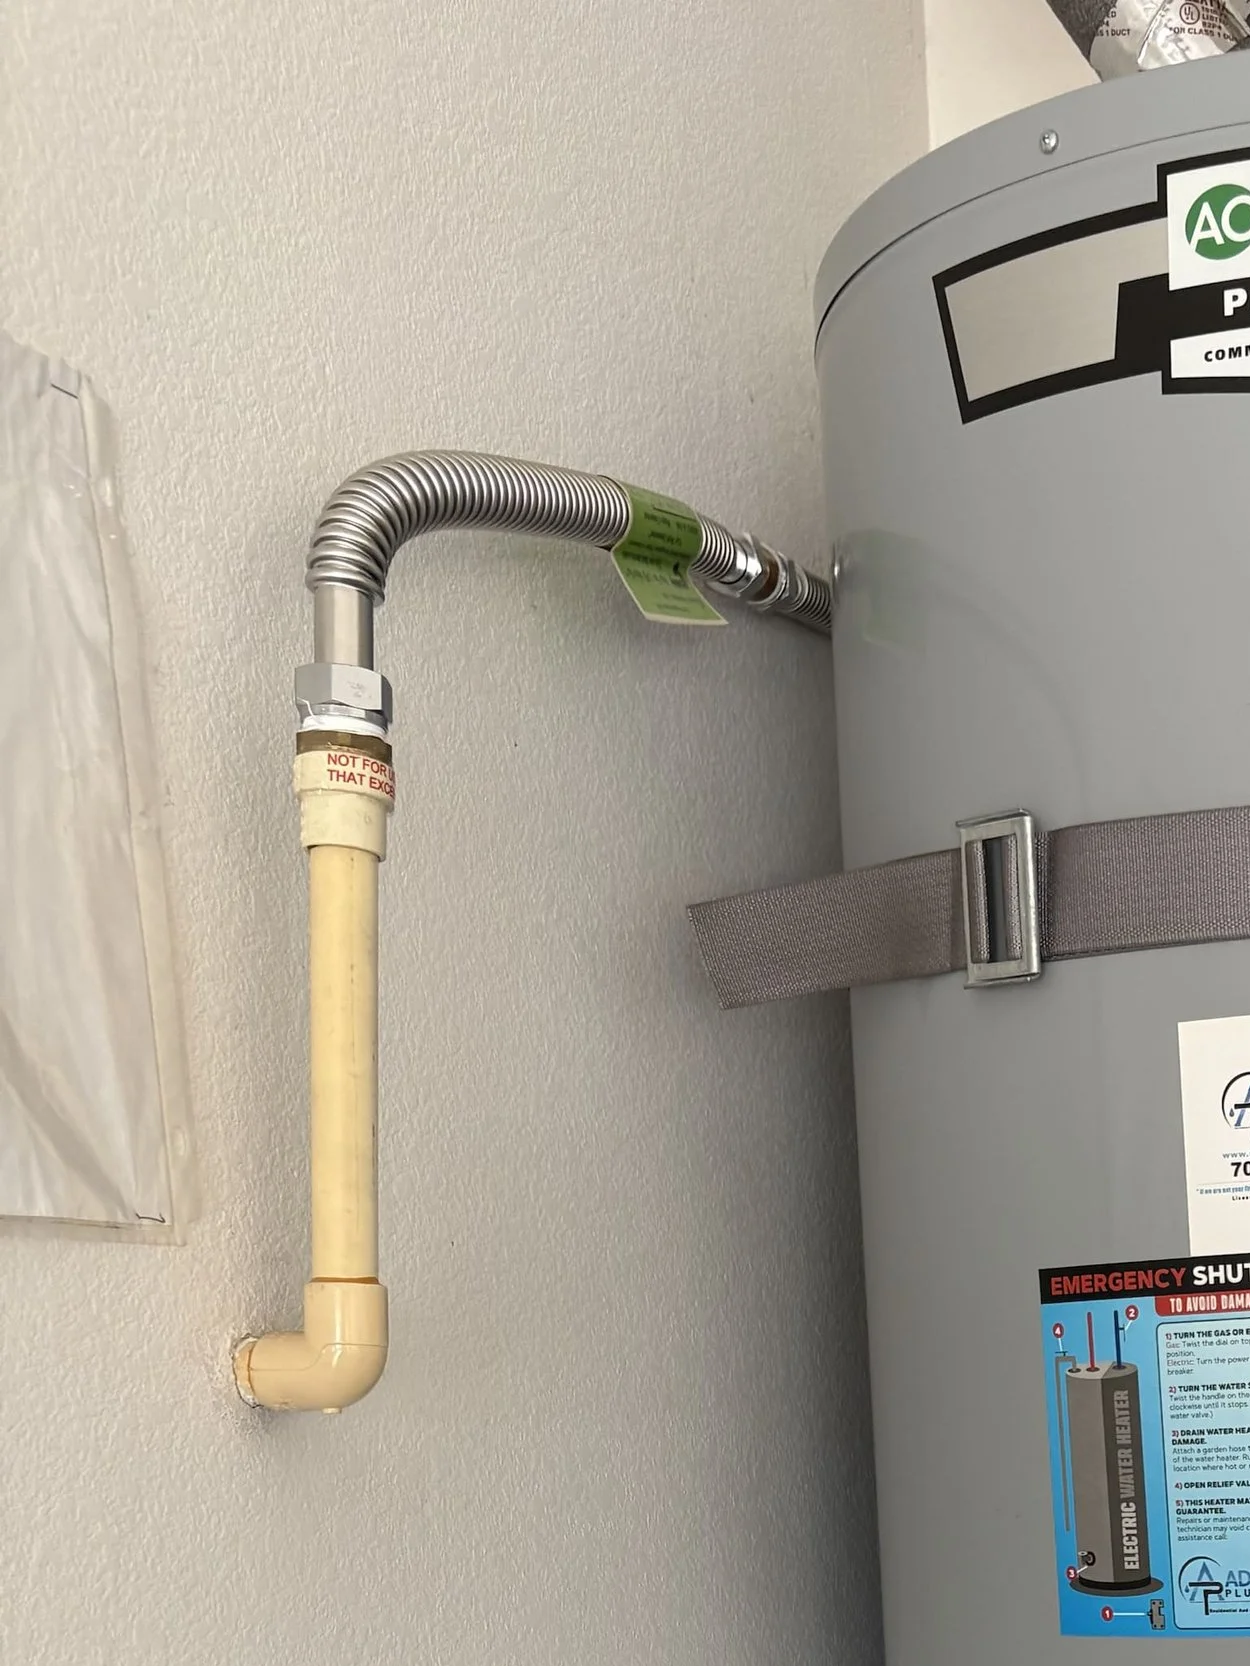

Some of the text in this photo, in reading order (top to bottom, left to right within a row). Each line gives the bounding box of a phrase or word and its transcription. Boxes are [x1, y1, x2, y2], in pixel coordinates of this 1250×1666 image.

[1111, 28, 1130, 37] DUCT
[1188, 27, 1214, 38] CLASS
[328, 753, 360, 767] NOT
[363, 759, 386, 778] FOR
[327, 769, 366, 785] THAT
[1050, 1267, 1186, 1296] EMERGENCY
[1170, 1299, 1181, 1313] TO
[1184, 1296, 1217, 1312] AVOID
[1174, 1332, 1195, 1340] TURN
[1214, 1329, 1231, 1337] GAS
[1114, 1390, 1140, 1571] ELECTRIC WATER HEATER
